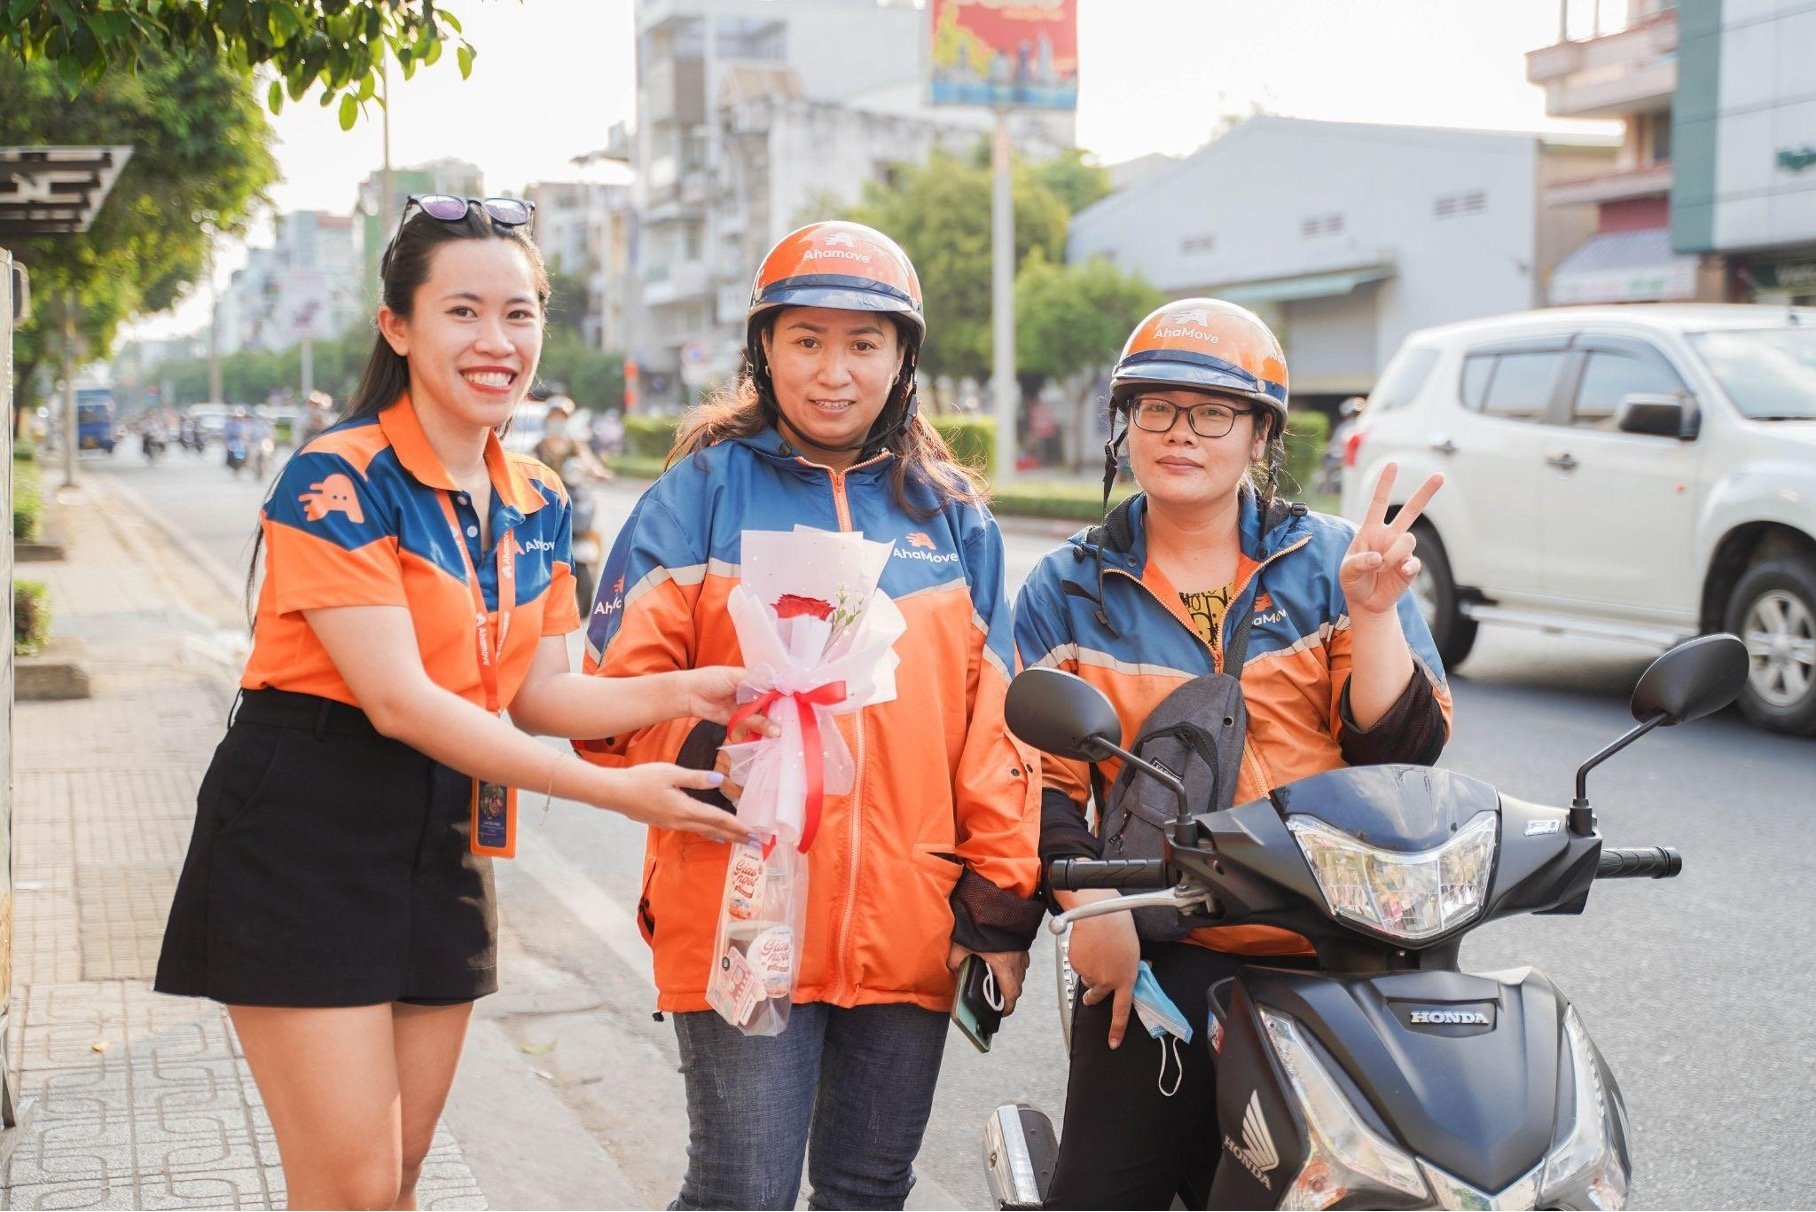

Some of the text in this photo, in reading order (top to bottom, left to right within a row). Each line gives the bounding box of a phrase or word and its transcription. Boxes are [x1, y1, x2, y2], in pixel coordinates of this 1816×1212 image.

[803, 248, 871, 264] Ahamove
[1153, 327, 1219, 345] AhaMove
[893, 548, 959, 563] AhaMove
[1410, 1010, 1490, 1025] HONDA
[1222, 1134, 1272, 1192] HONDA
